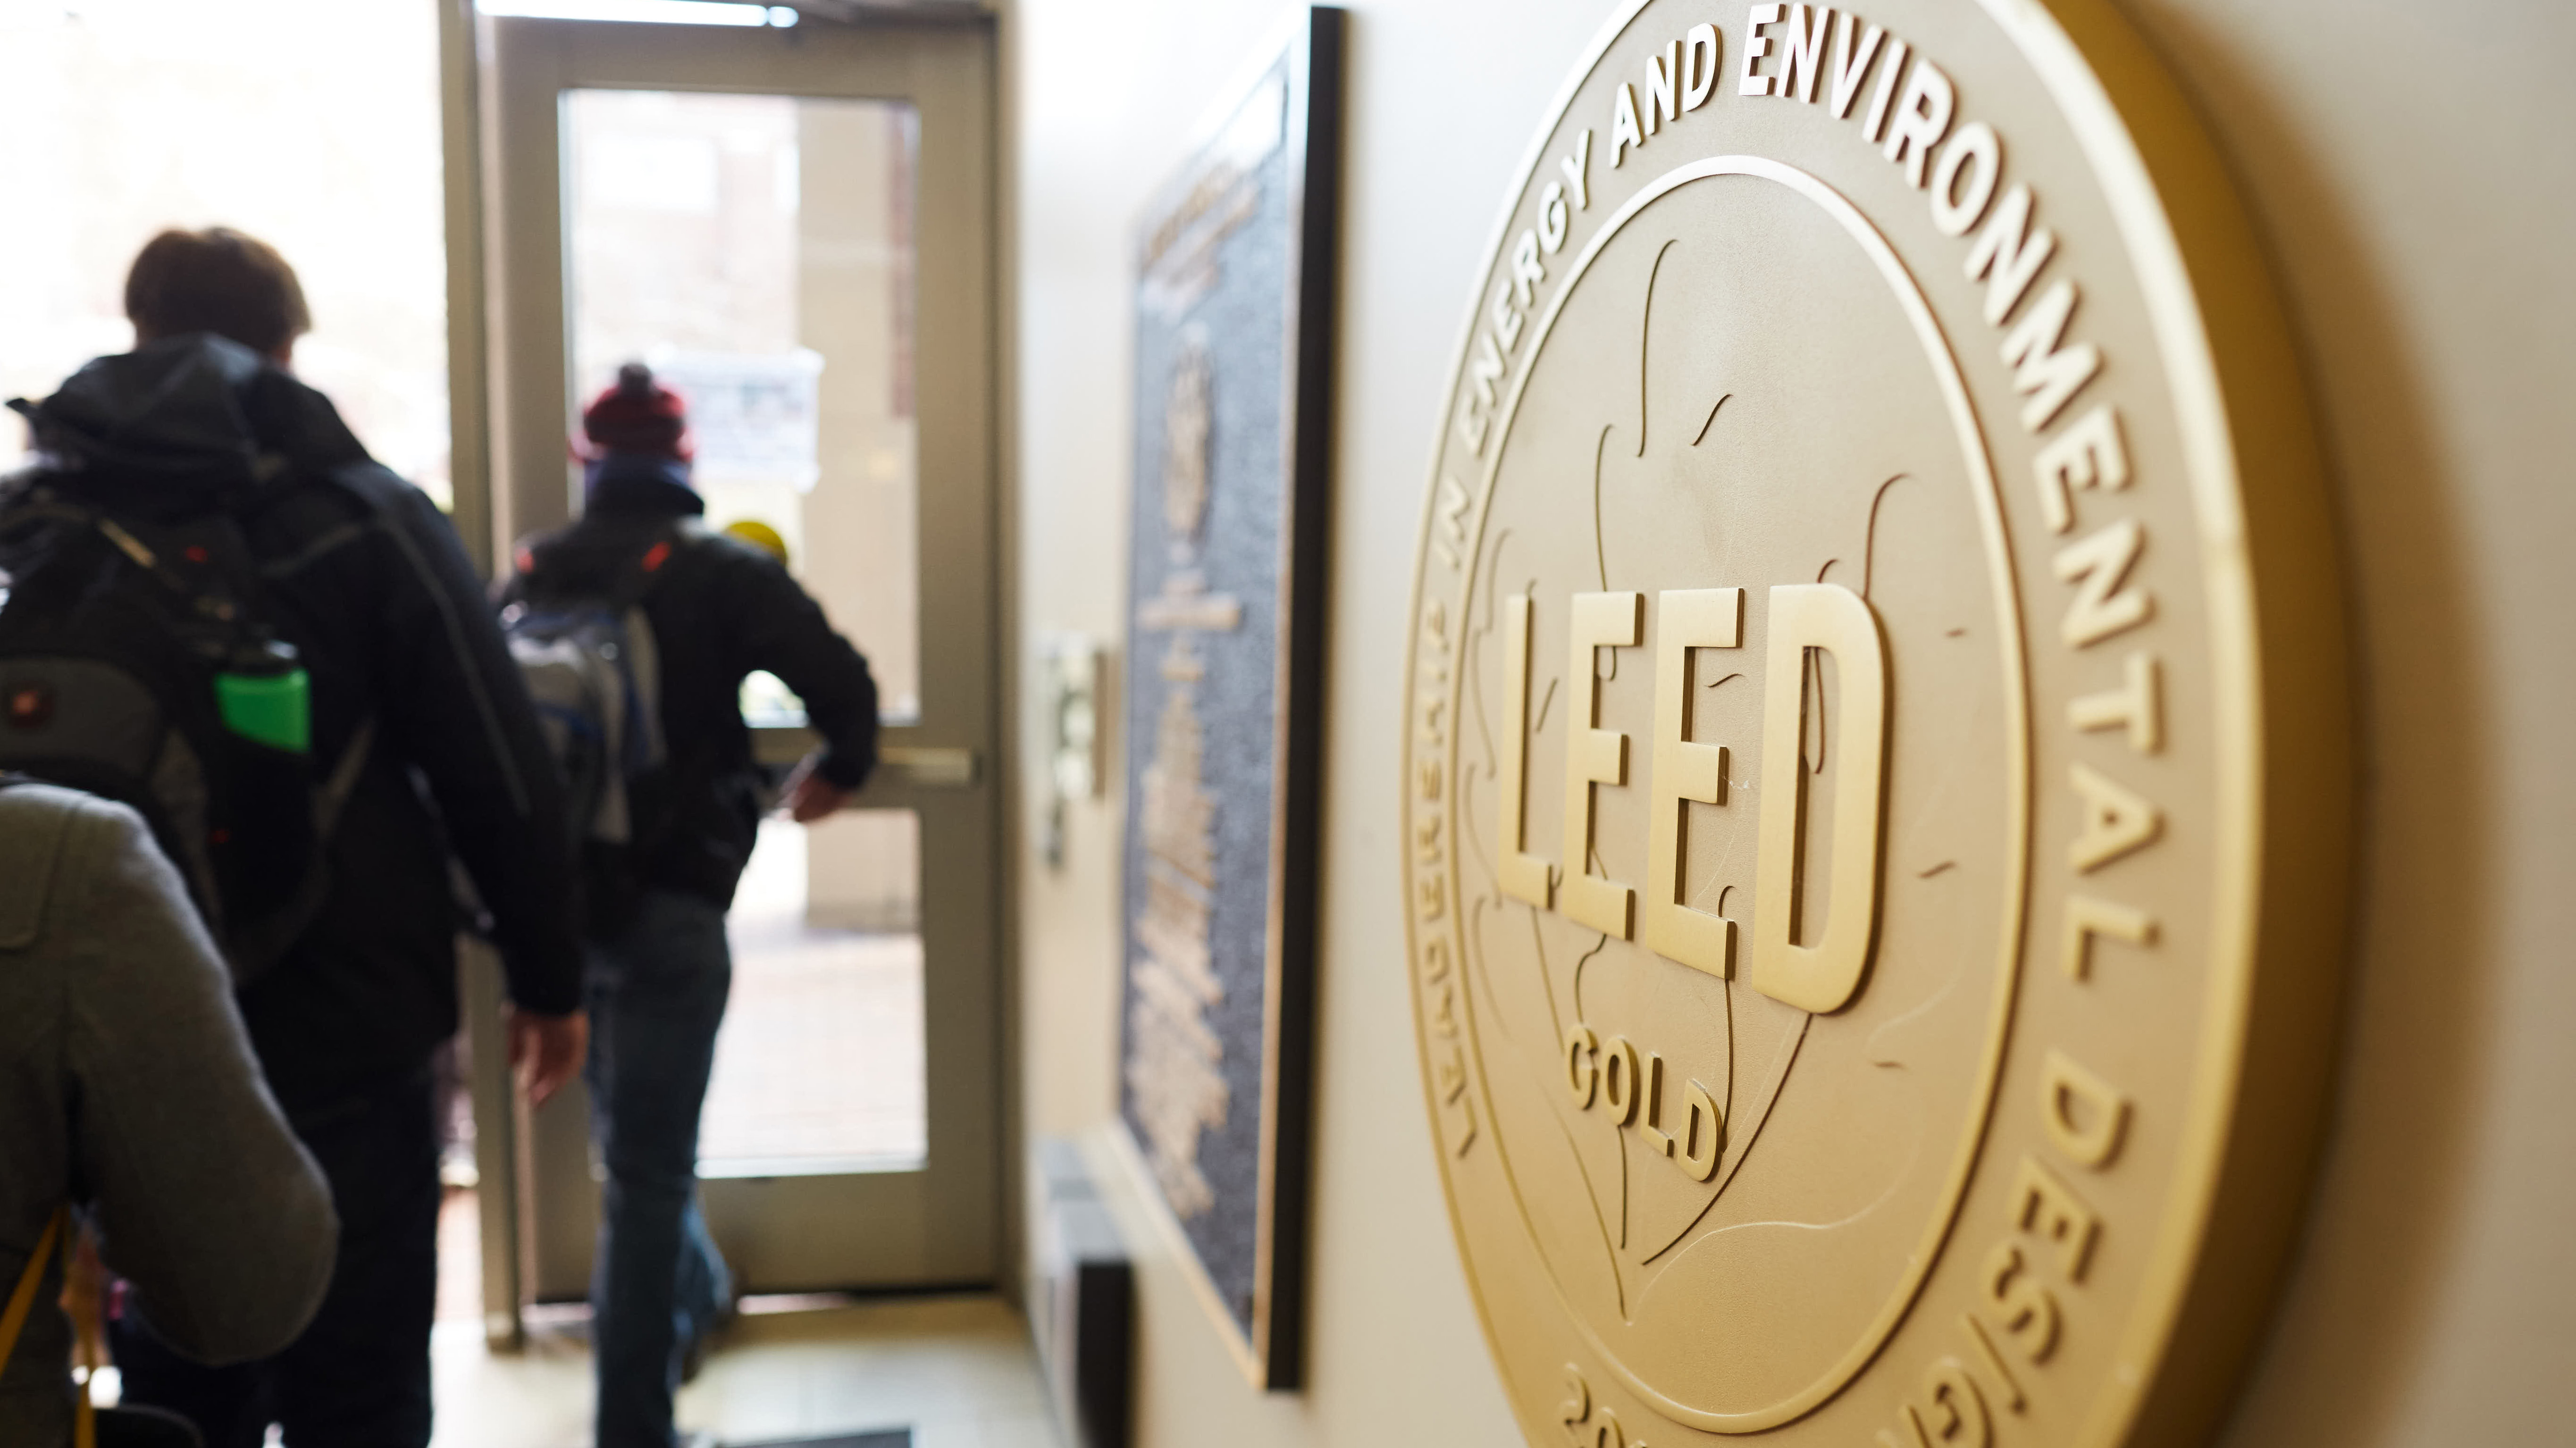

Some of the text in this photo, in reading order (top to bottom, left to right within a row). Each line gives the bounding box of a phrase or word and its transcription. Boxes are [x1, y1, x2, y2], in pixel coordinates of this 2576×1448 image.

[1609, 24, 1722, 167] AND
[1456, 130, 1592, 457] ENERGY
[1435, 474, 1470, 569] IN
[1738, 3, 2166, 983] ENVIRONMENTAL
[1418, 597, 1478, 1159] LEADERSHIP
[1498, 584, 1883, 1014] LEED
[1564, 1024, 1725, 1182] GOLD
